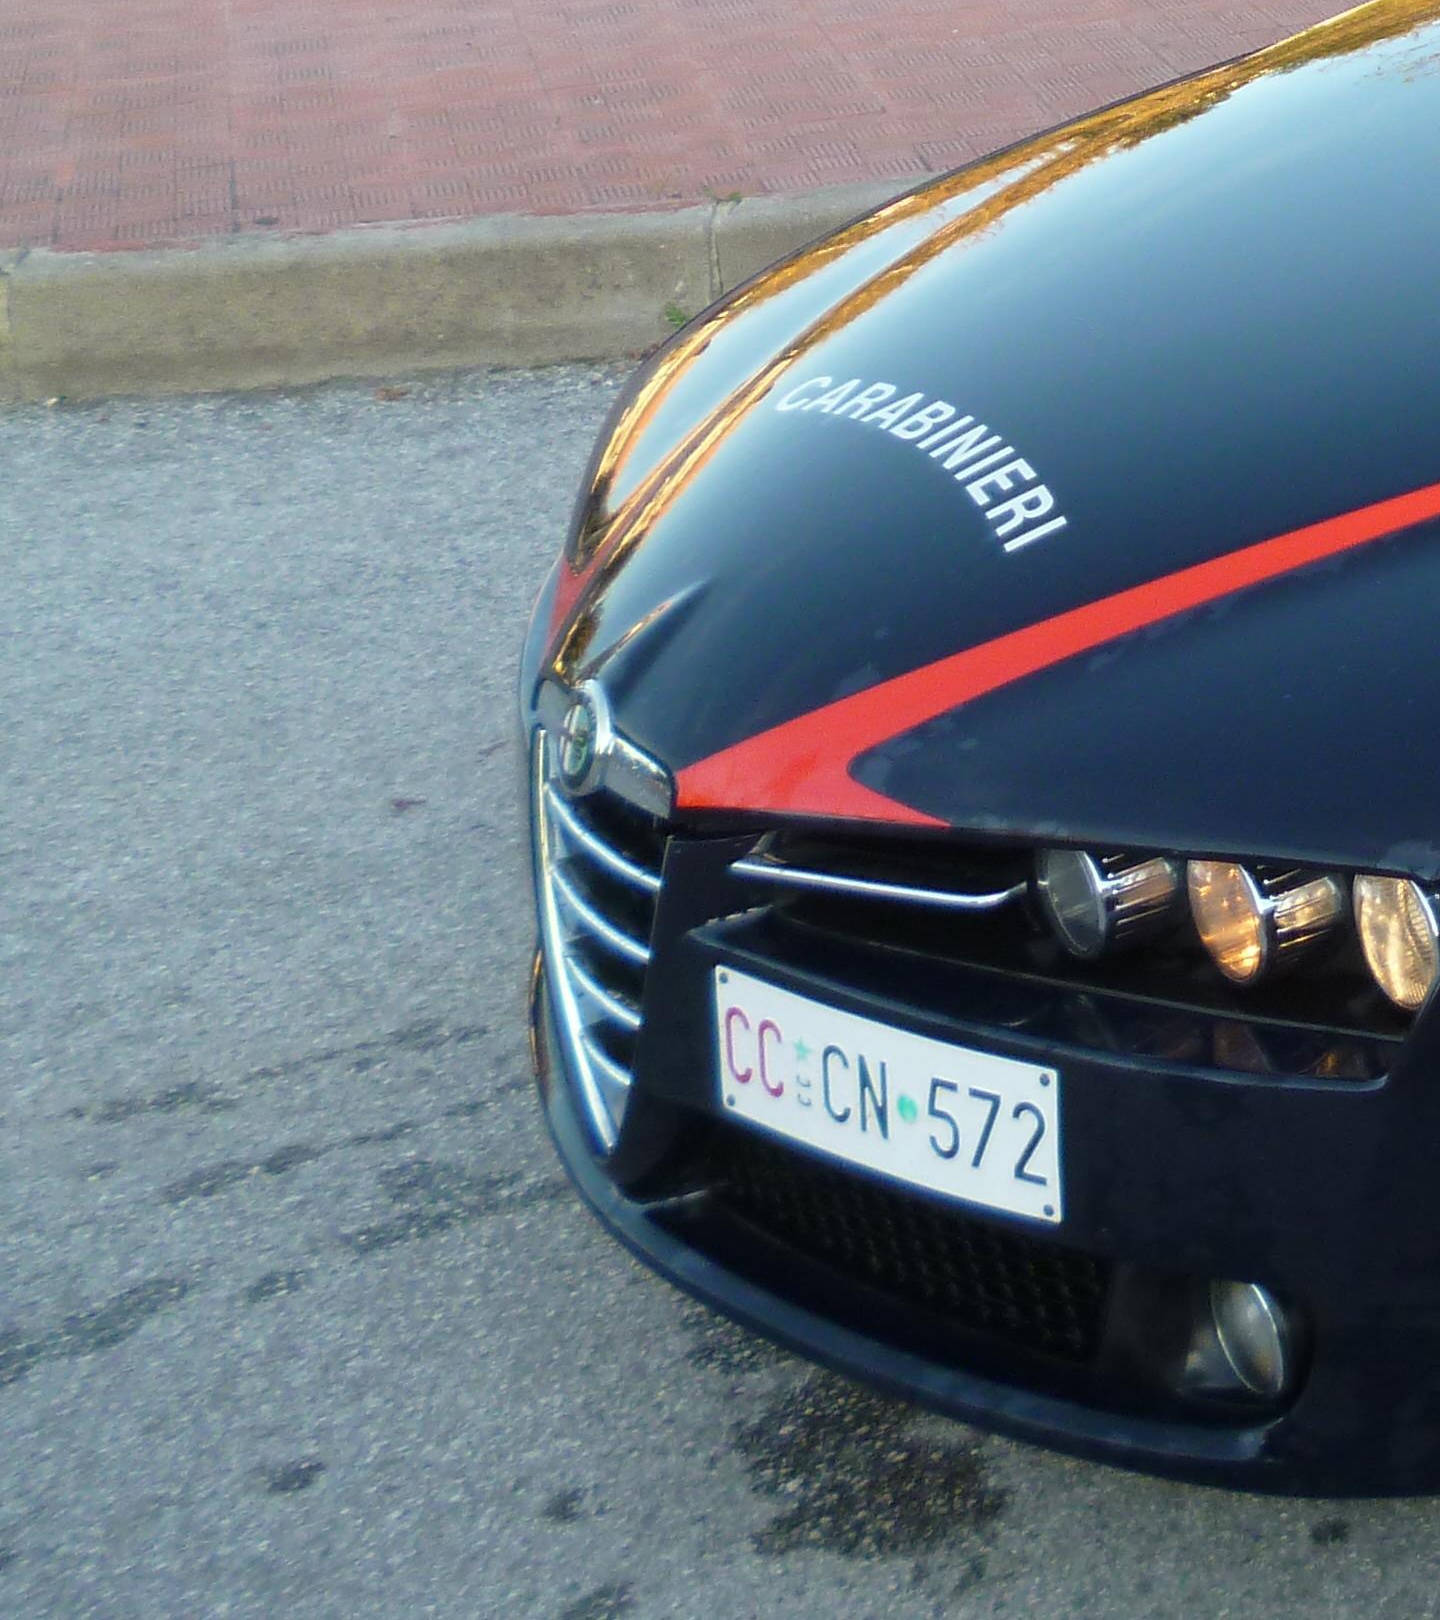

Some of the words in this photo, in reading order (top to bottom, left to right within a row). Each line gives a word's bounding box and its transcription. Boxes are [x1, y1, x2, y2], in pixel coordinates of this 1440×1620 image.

[775, 375, 1069, 553] CARABINIERI
[724, 1006, 785, 1099] CC
[821, 1044, 890, 1141] CN
[927, 1076, 1049, 1187] 572
